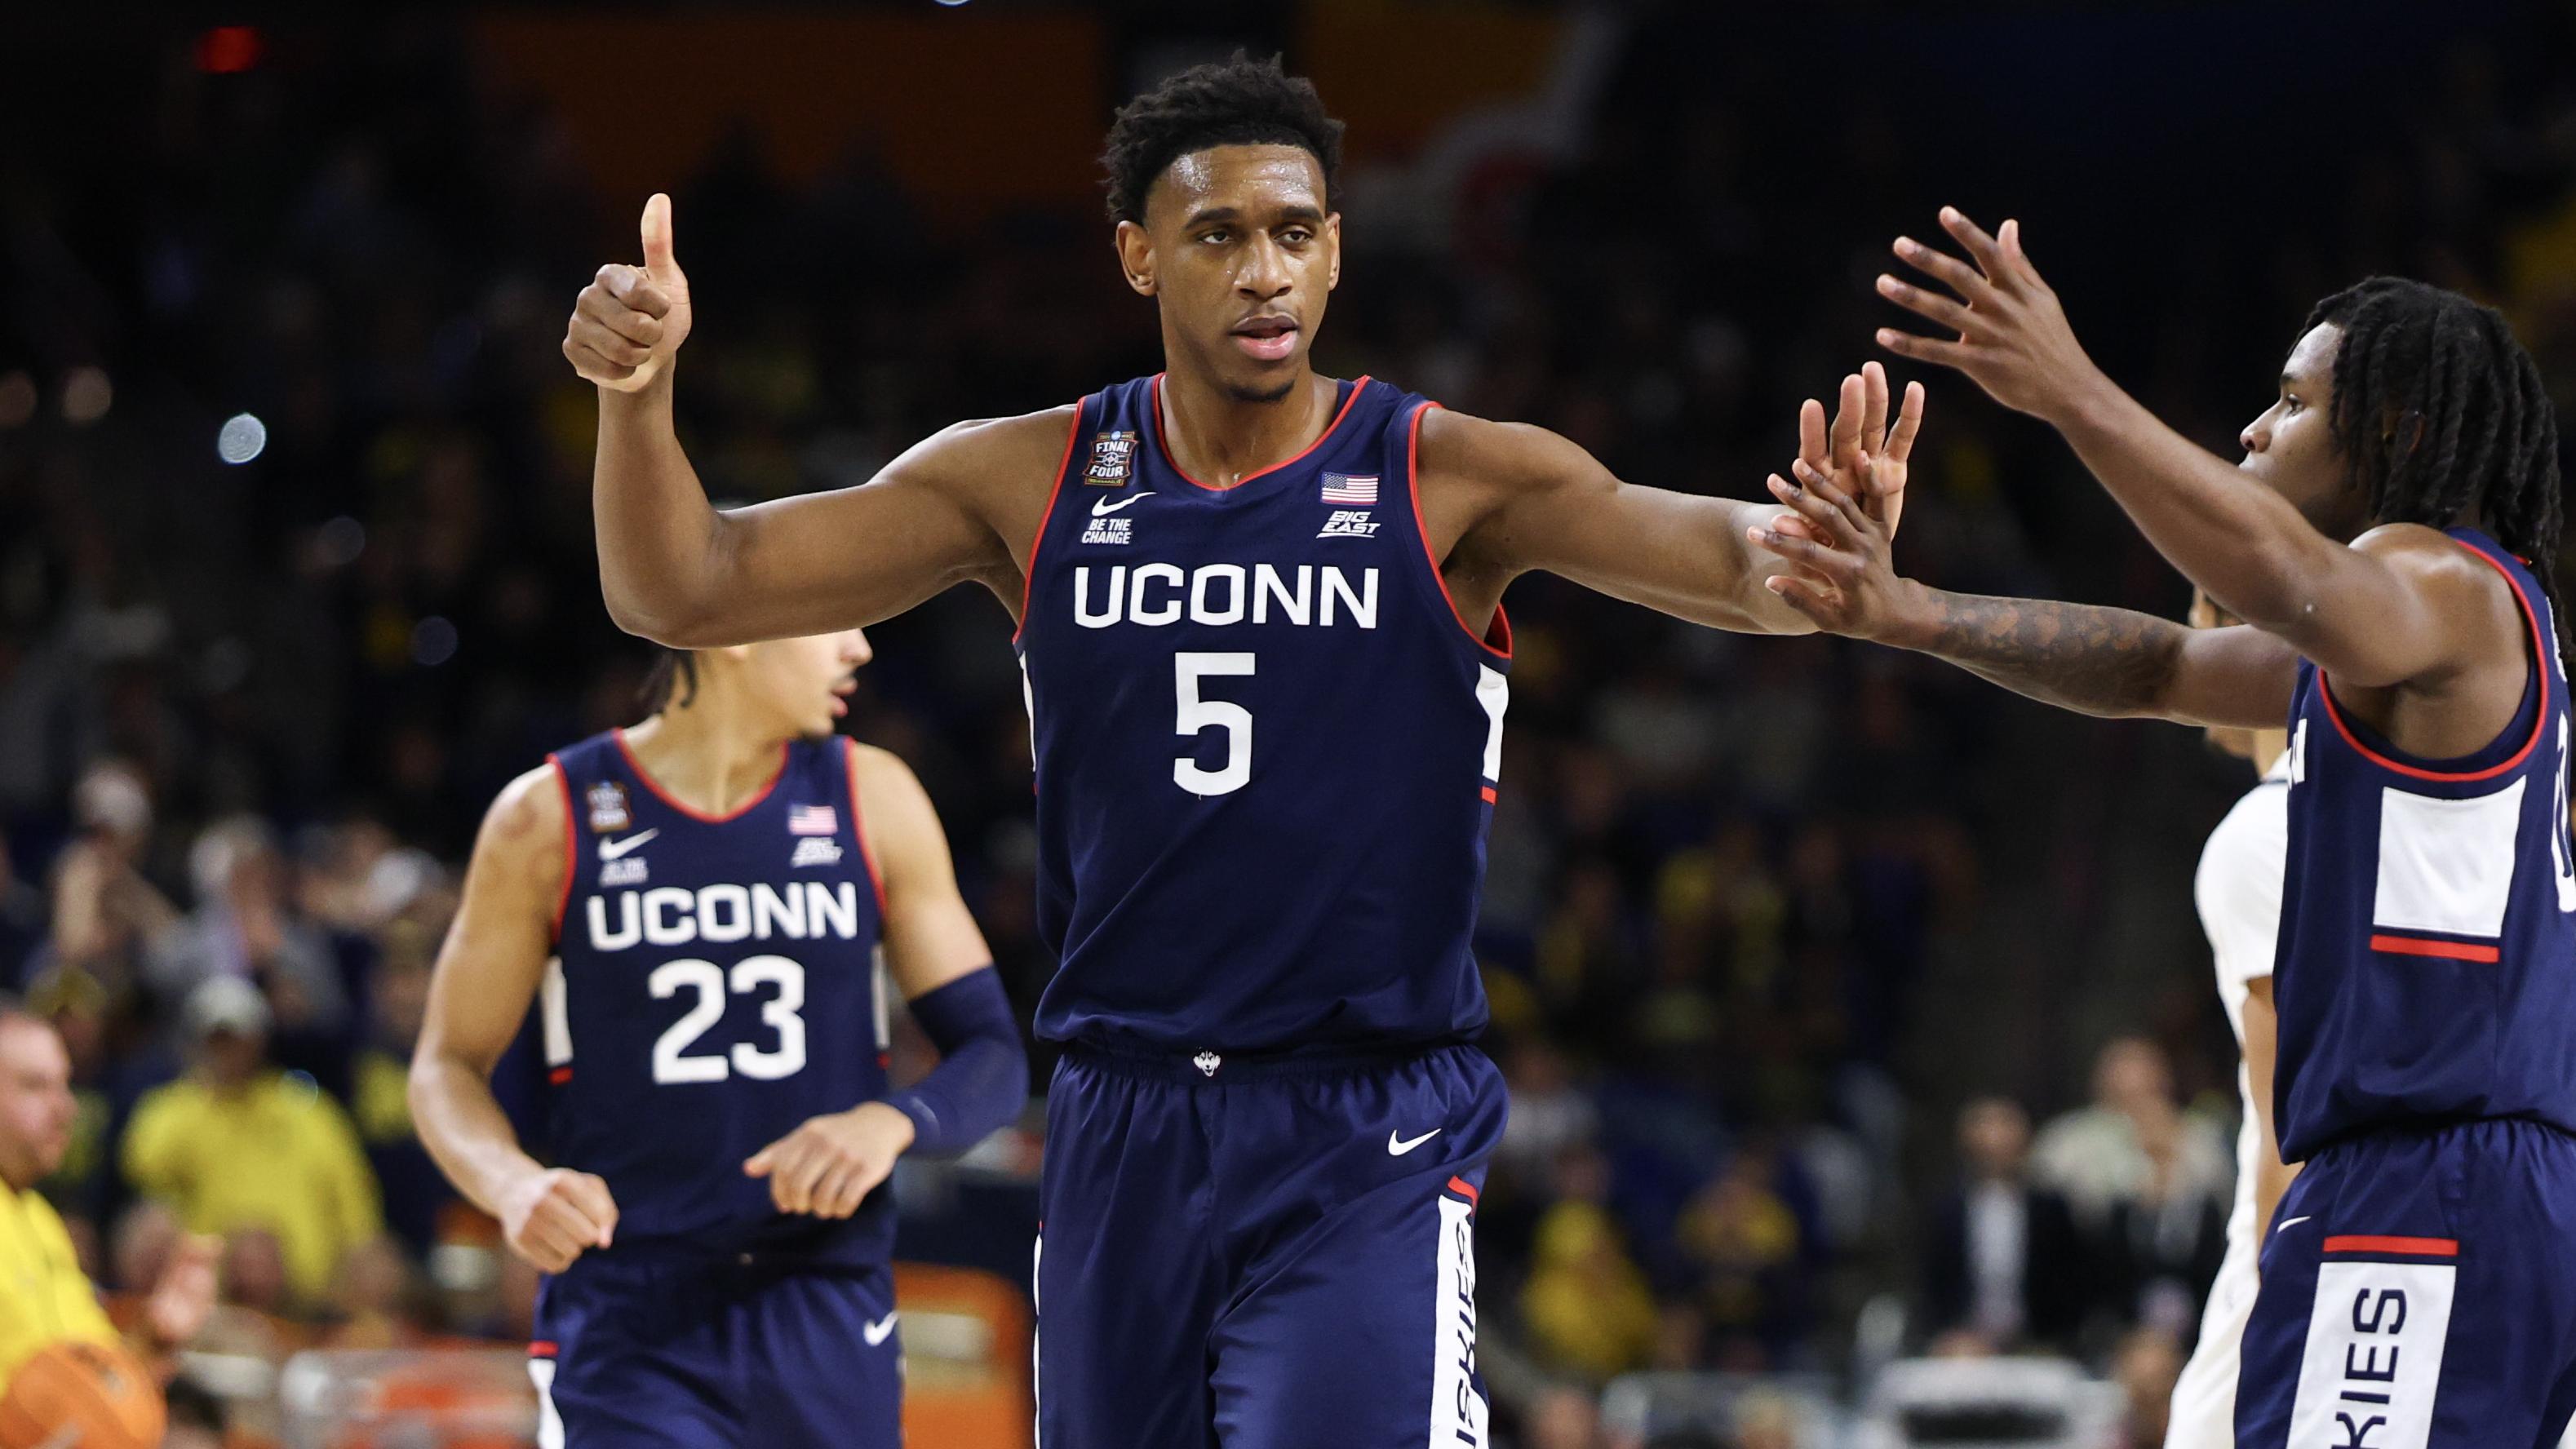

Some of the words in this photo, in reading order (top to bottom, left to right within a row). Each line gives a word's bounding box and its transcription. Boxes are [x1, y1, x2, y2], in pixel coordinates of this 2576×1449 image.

[1096, 441, 1129, 453] FINAL
[1089, 465, 1124, 477] FOUR
[1328, 510, 1372, 522] BIG
[1088, 518, 1107, 531] BE
[1109, 518, 1133, 531] THE
[1321, 521, 1381, 534] EAST
[1081, 531, 1132, 545] CHANGE
[1075, 563, 1379, 629] UCONN
[1173, 652, 1256, 796] 5
[587, 881, 858, 951] UCONN
[648, 955, 807, 1084] 23
[1456, 1221, 1477, 1449] SKIES
